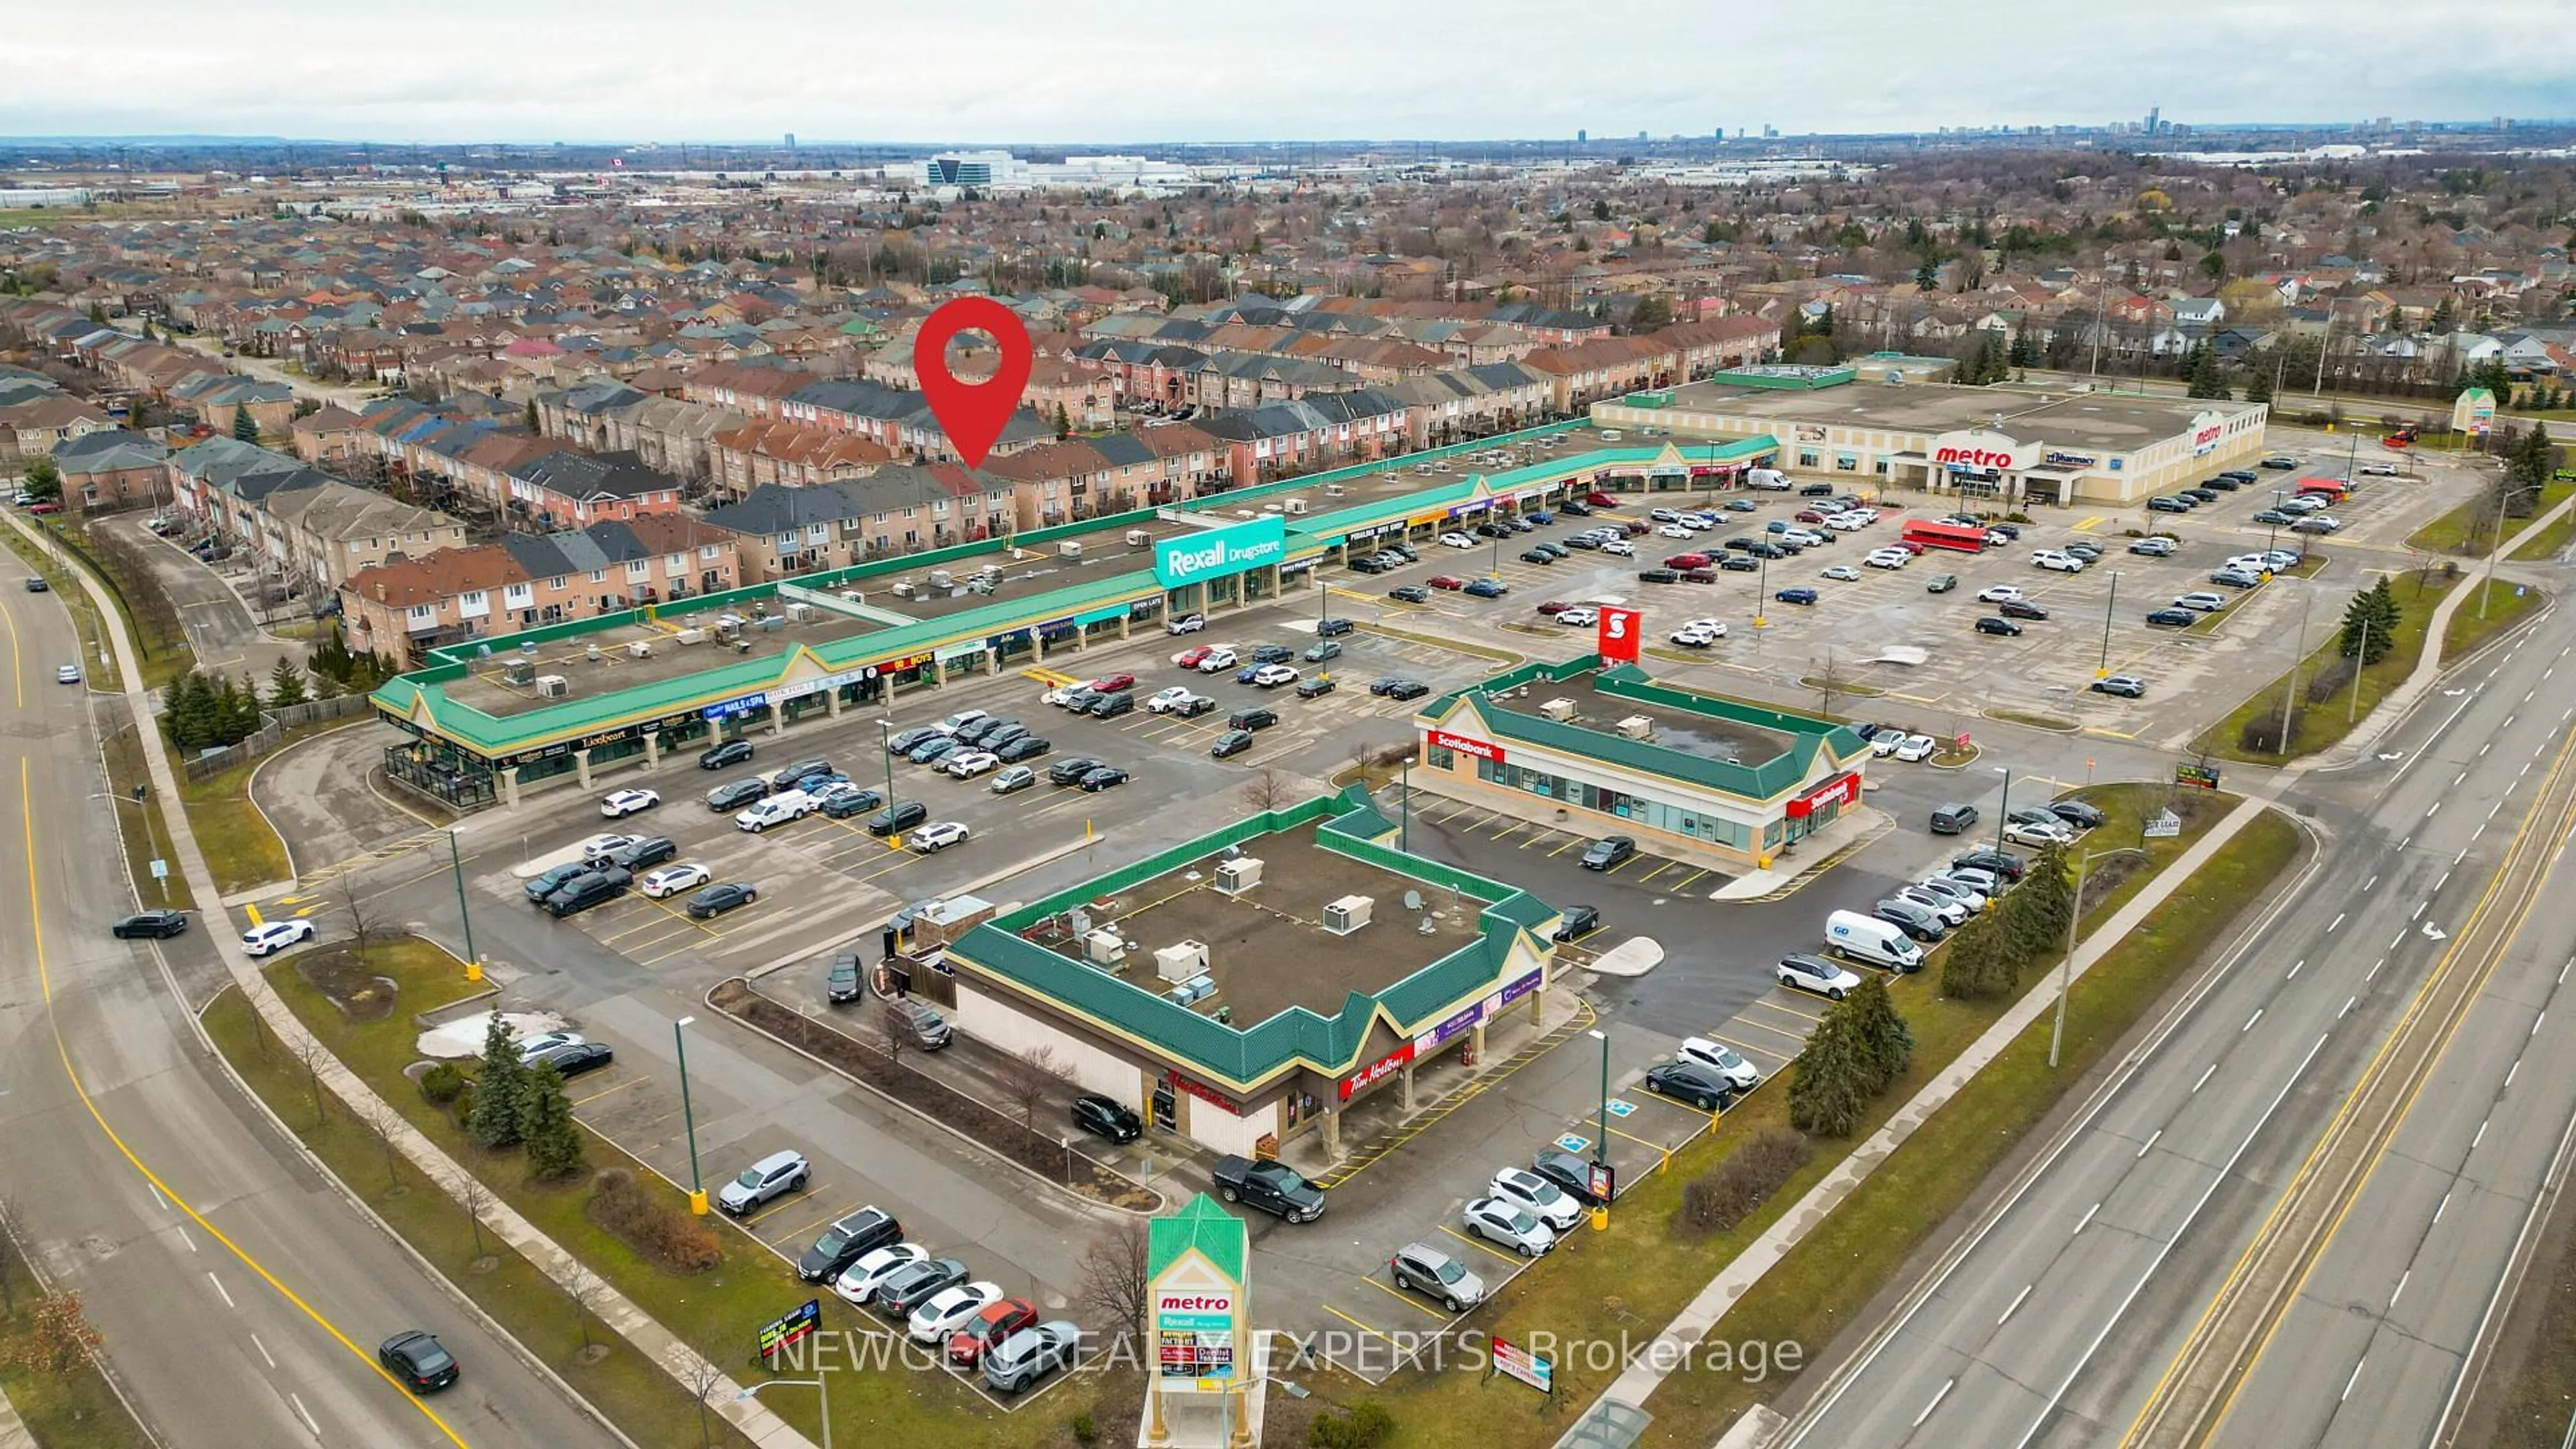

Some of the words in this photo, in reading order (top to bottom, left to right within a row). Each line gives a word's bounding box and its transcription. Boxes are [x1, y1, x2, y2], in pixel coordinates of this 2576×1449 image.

[2196, 425, 2220, 445] metro
[1936, 447, 2011, 468] metro
[1169, 540, 1225, 578] Rexall
[1229, 539, 1281, 562] Drugstore
[1148, 596, 1162, 606] LATE
[724, 700, 746, 713] NAILS
[750, 695, 764, 708] SPA
[1438, 733, 1493, 759] Scotiabank
[1350, 1072, 1368, 1093] Tim
[1368, 1057, 1403, 1083] Hortons
[1162, 1297, 1228, 1309] metro
[1199, 1348, 1230, 1356] Dentist
